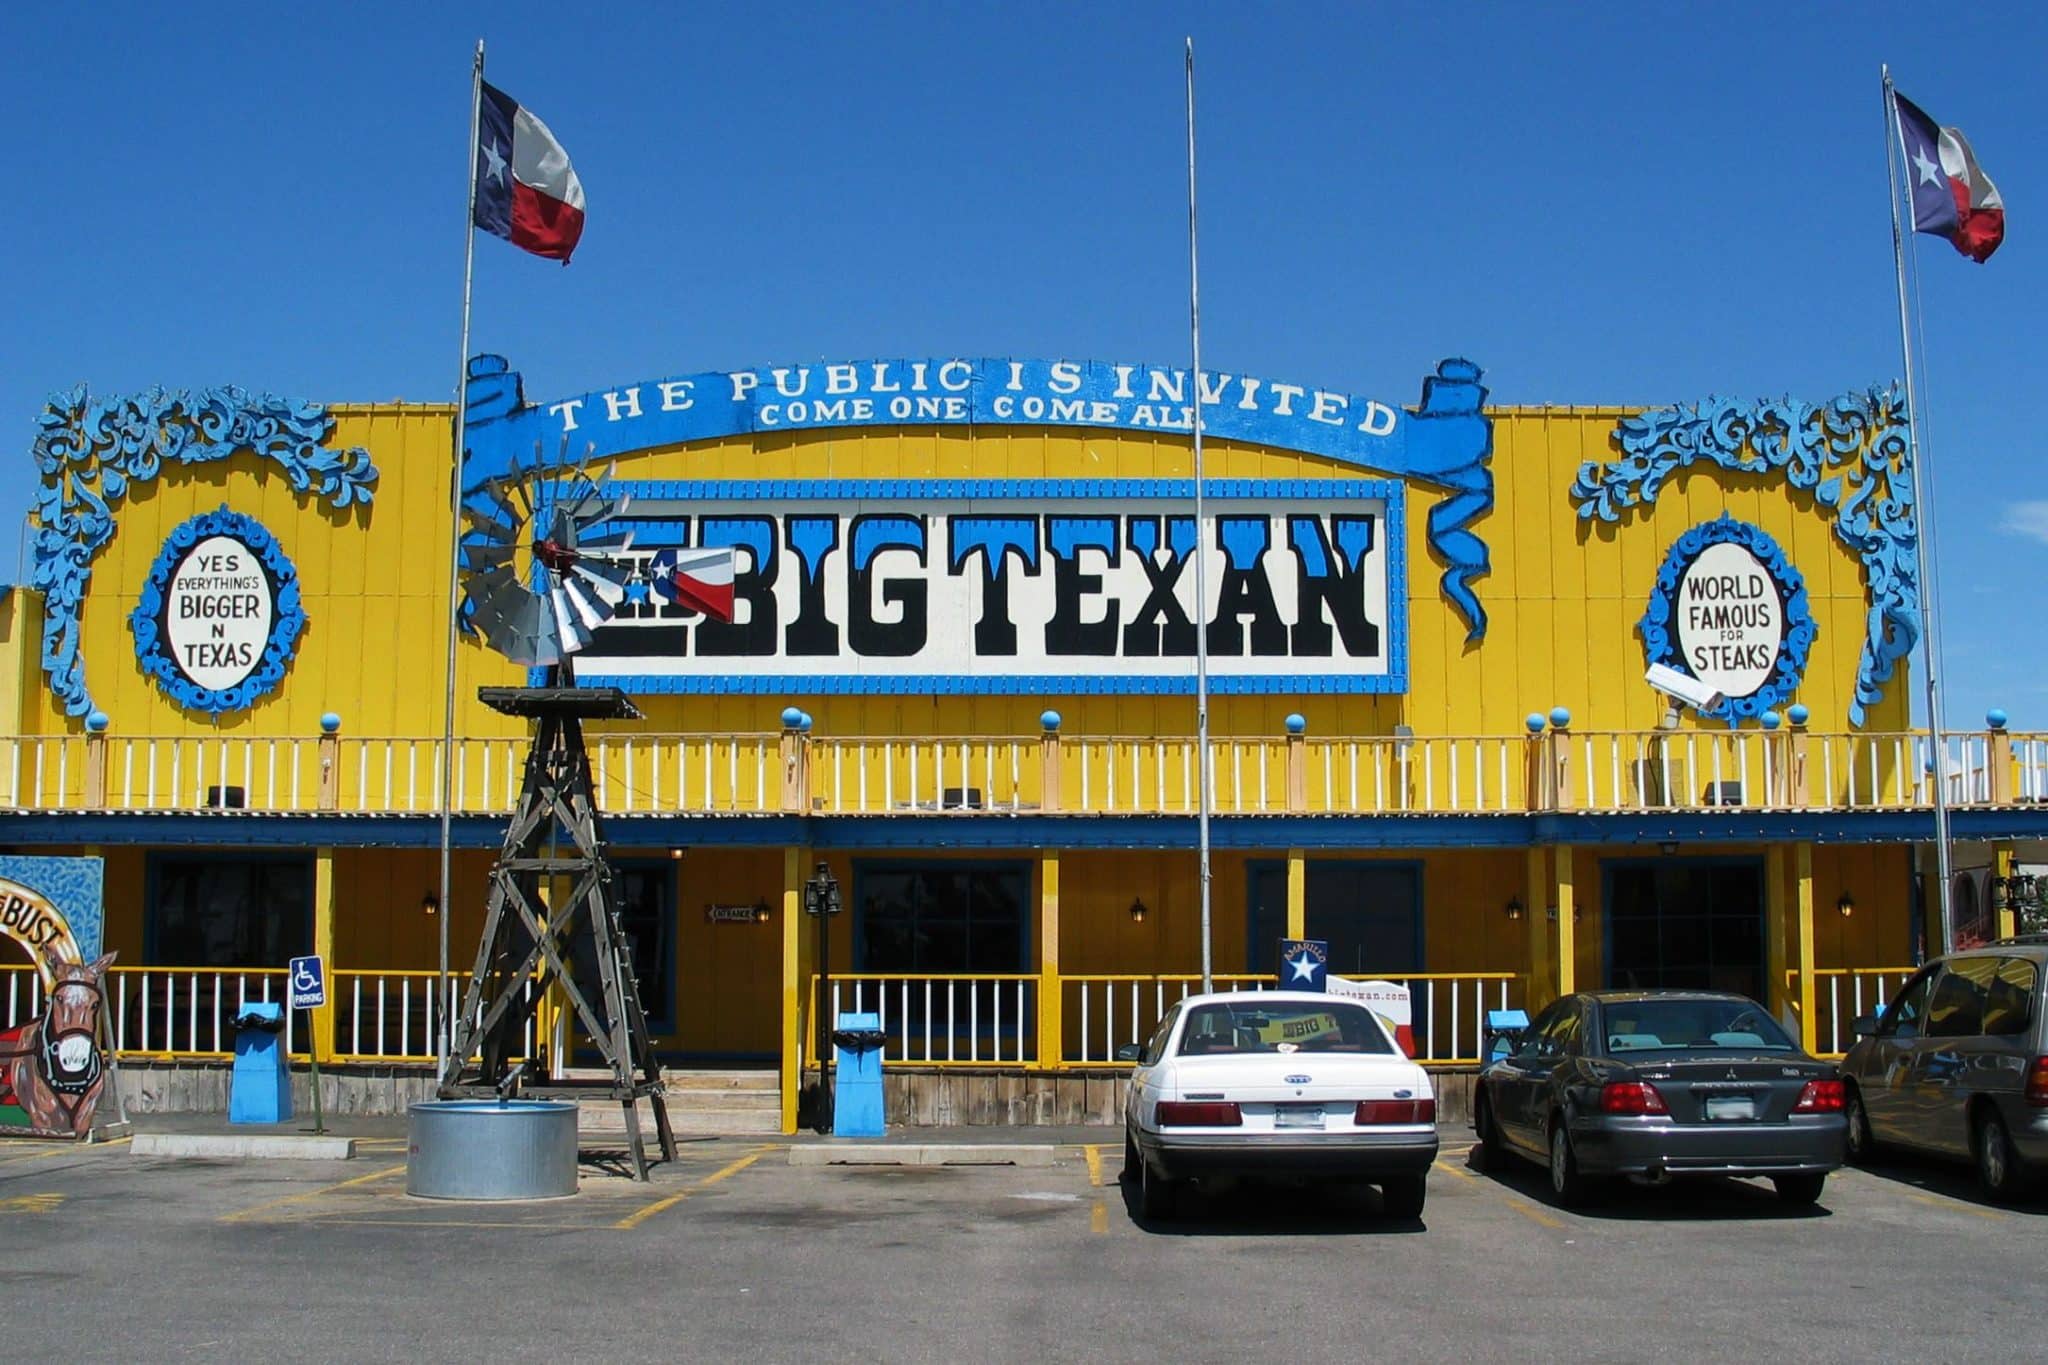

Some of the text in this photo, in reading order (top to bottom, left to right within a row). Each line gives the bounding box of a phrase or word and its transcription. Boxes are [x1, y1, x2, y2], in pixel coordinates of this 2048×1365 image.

[550, 362, 1397, 436] THE PUBLIC IS INVITED
[760, 398, 873, 425] COME
[890, 397, 966, 419] ONE
[993, 397, 1120, 423] COME
[198, 555, 239, 572] YES
[177, 576, 259, 590] EVERYTHING'S
[695, 513, 928, 657] BIG
[948, 513, 1380, 657] TEXAN
[1688, 575, 1764, 601] WORLD
[180, 594, 260, 619] BIGGER
[1690, 603, 1770, 630] FAMOUS
[211, 623, 225, 638] N
[1720, 630, 1743, 641] FOR
[184, 643, 252, 667] TEXAS
[1694, 644, 1770, 671] STEAKS
[4, 896, 65, 951] BUST
[1284, 943, 1326, 963] AMARILLO
[295, 992, 322, 1003] PARKING
[1296, 1017, 1320, 1036] BIG
